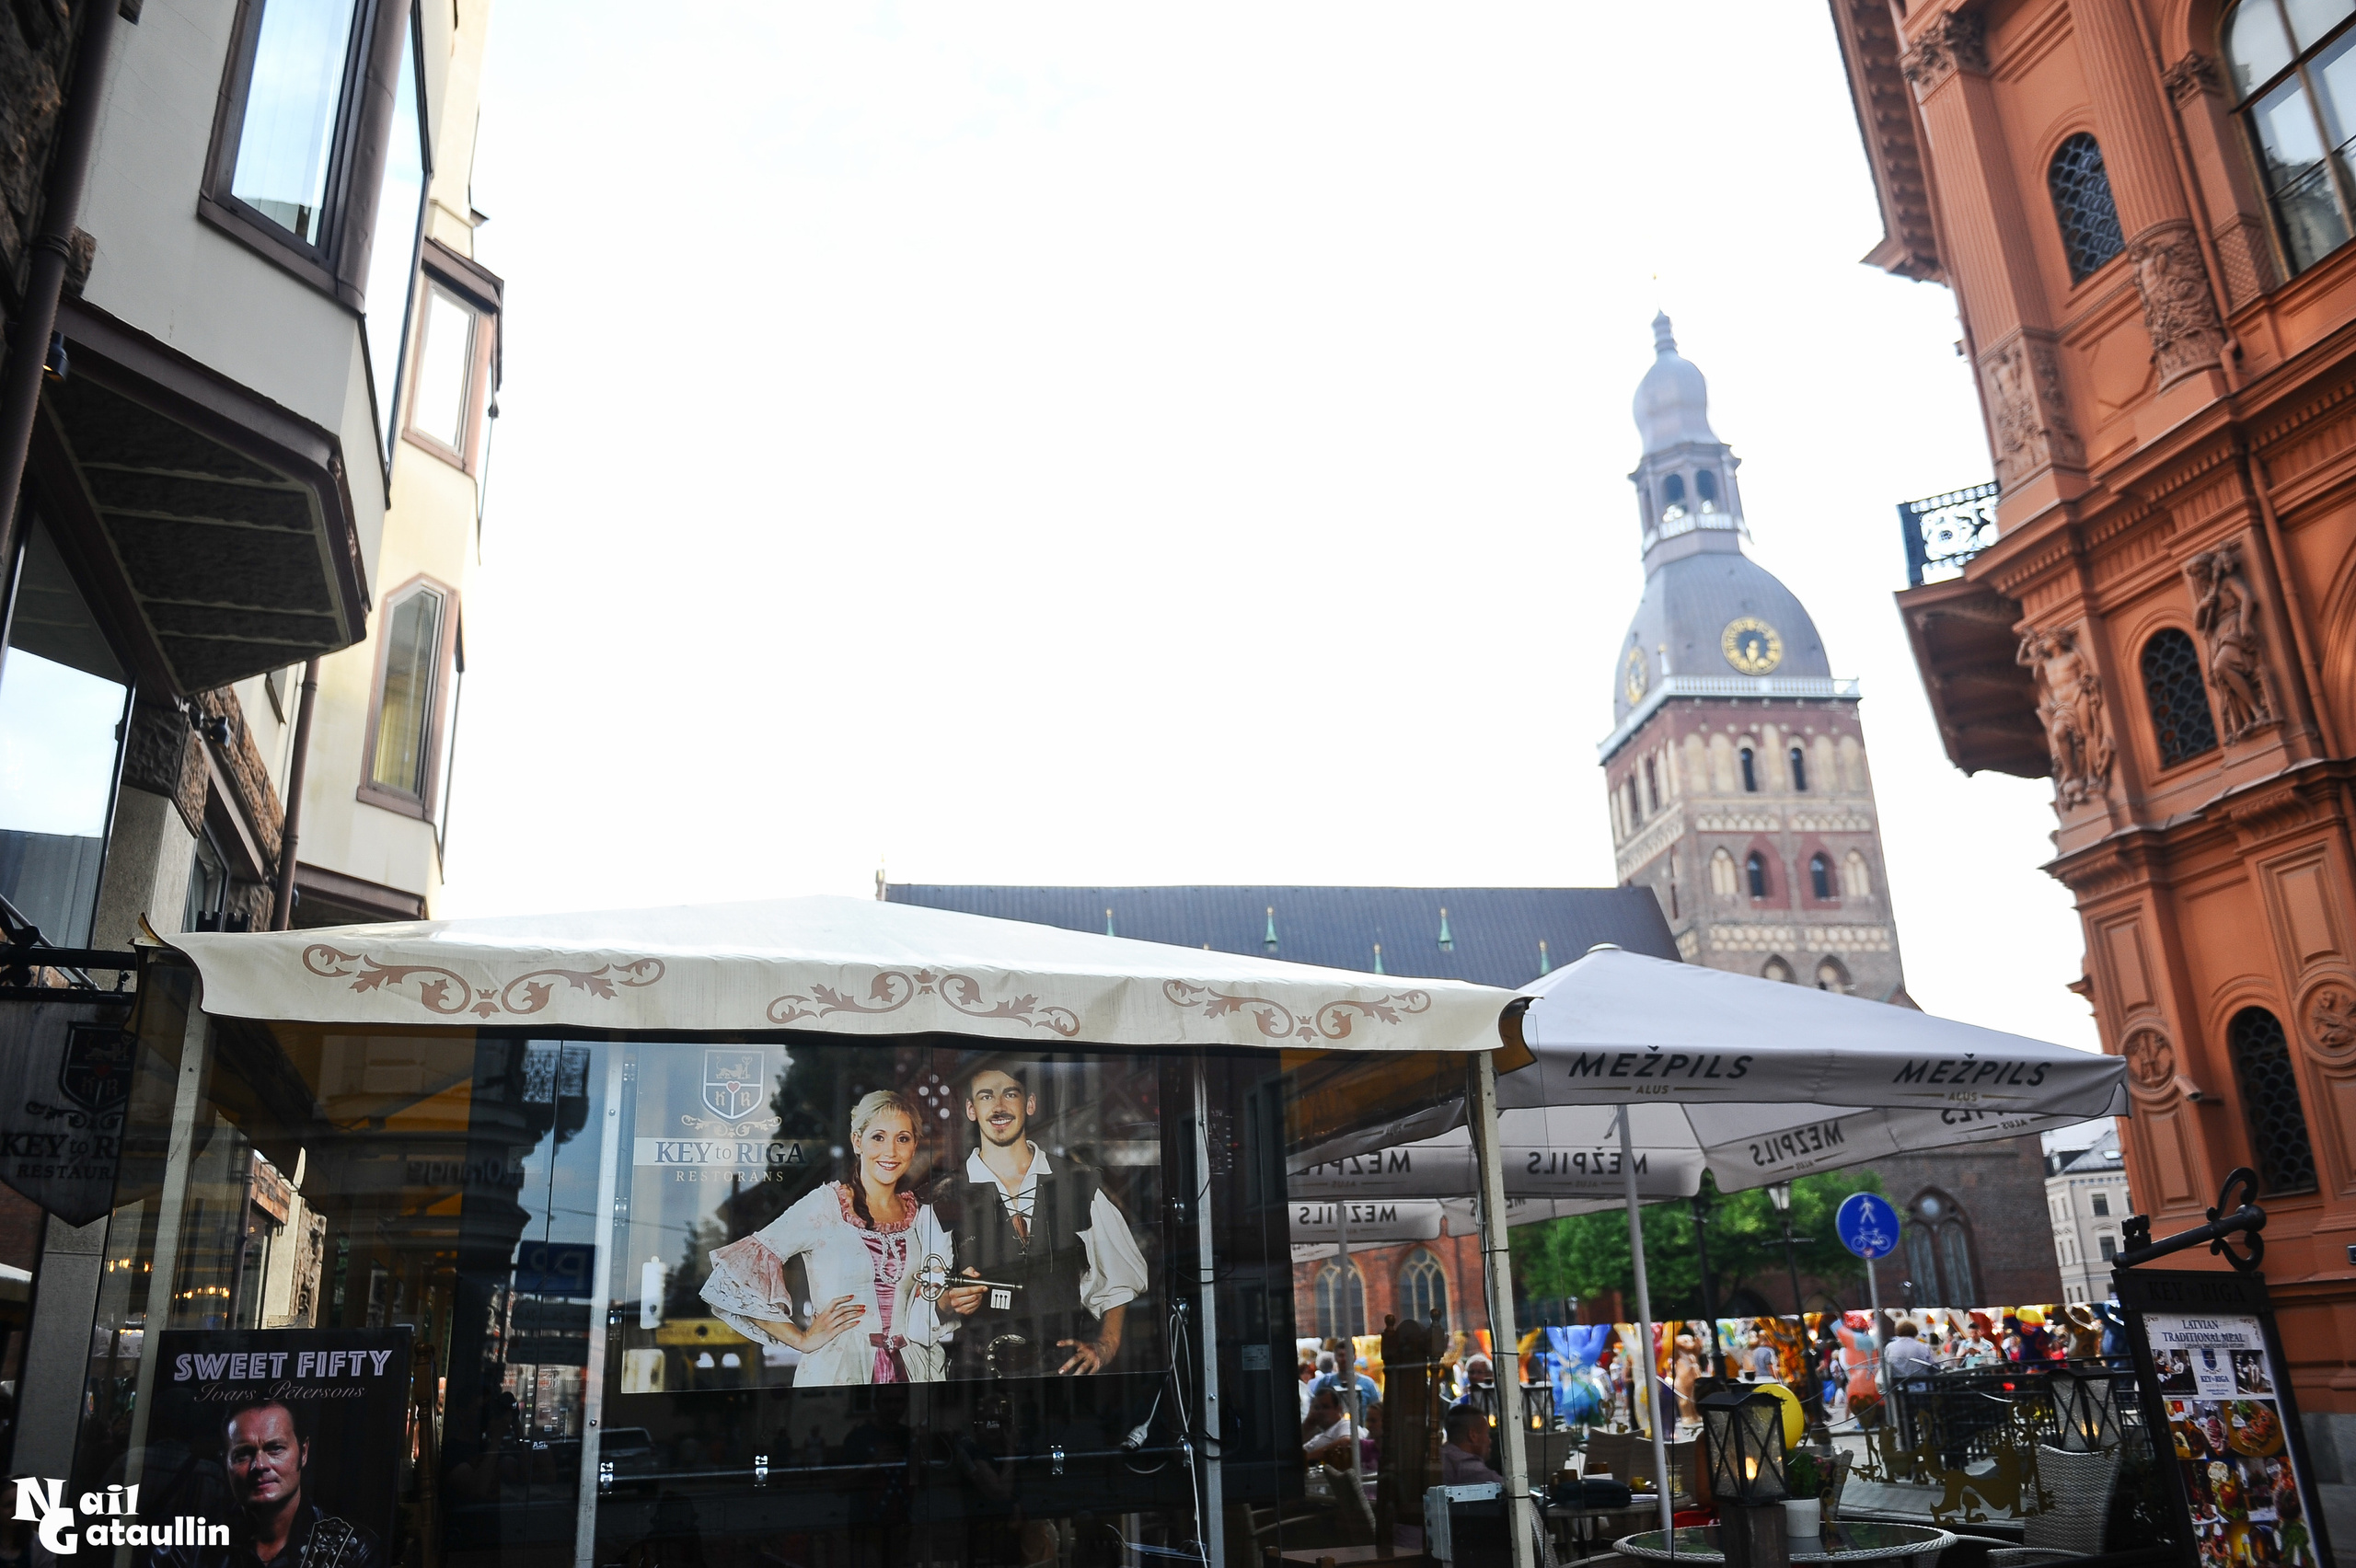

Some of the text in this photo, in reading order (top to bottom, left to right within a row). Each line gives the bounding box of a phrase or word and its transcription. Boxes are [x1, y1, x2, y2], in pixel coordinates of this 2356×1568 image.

[1568, 1045, 1753, 1078] MEŽPILS
[1892, 1053, 2052, 1087] MEŽPILS
[1635, 1085, 1669, 1094] ALUS
[1948, 1091, 1978, 1101] ALUS
[0, 1133, 69, 1157] KEY
[70, 1138, 88, 1154] to
[654, 1141, 806, 1164] KEY to RIGA
[676, 1169, 784, 1182] RESTORĀNS
[2147, 1281, 2184, 1301] KEY
[2200, 1282, 2246, 1302] RIGA
[2182, 1320, 2220, 1330] LATVIAN
[2162, 1332, 2246, 1343] TRADITIONAL MEAL
[174, 1350, 393, 1380] SWEET FIFTY
[194, 1380, 365, 1402] Ivars Pētersons
